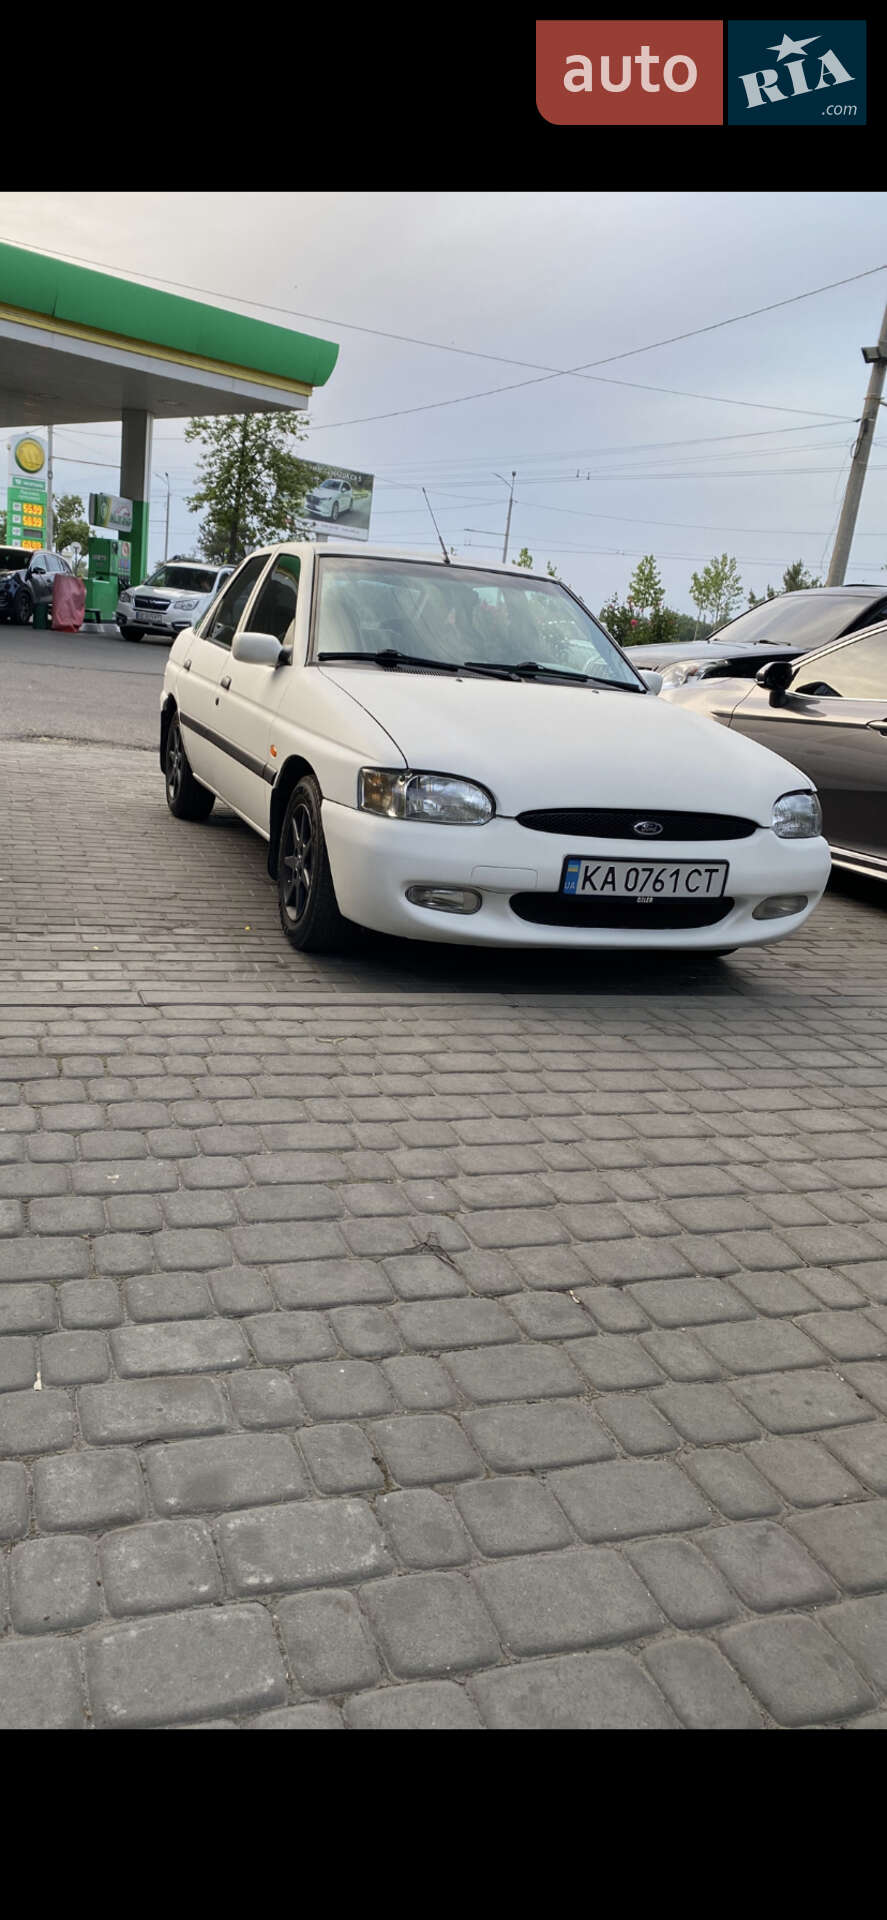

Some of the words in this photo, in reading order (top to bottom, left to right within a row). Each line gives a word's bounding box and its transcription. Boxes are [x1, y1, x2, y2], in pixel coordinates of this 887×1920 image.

[581, 865, 616, 892] KA
[624, 867, 681, 893] 0761
[685, 868, 720, 893] CT
